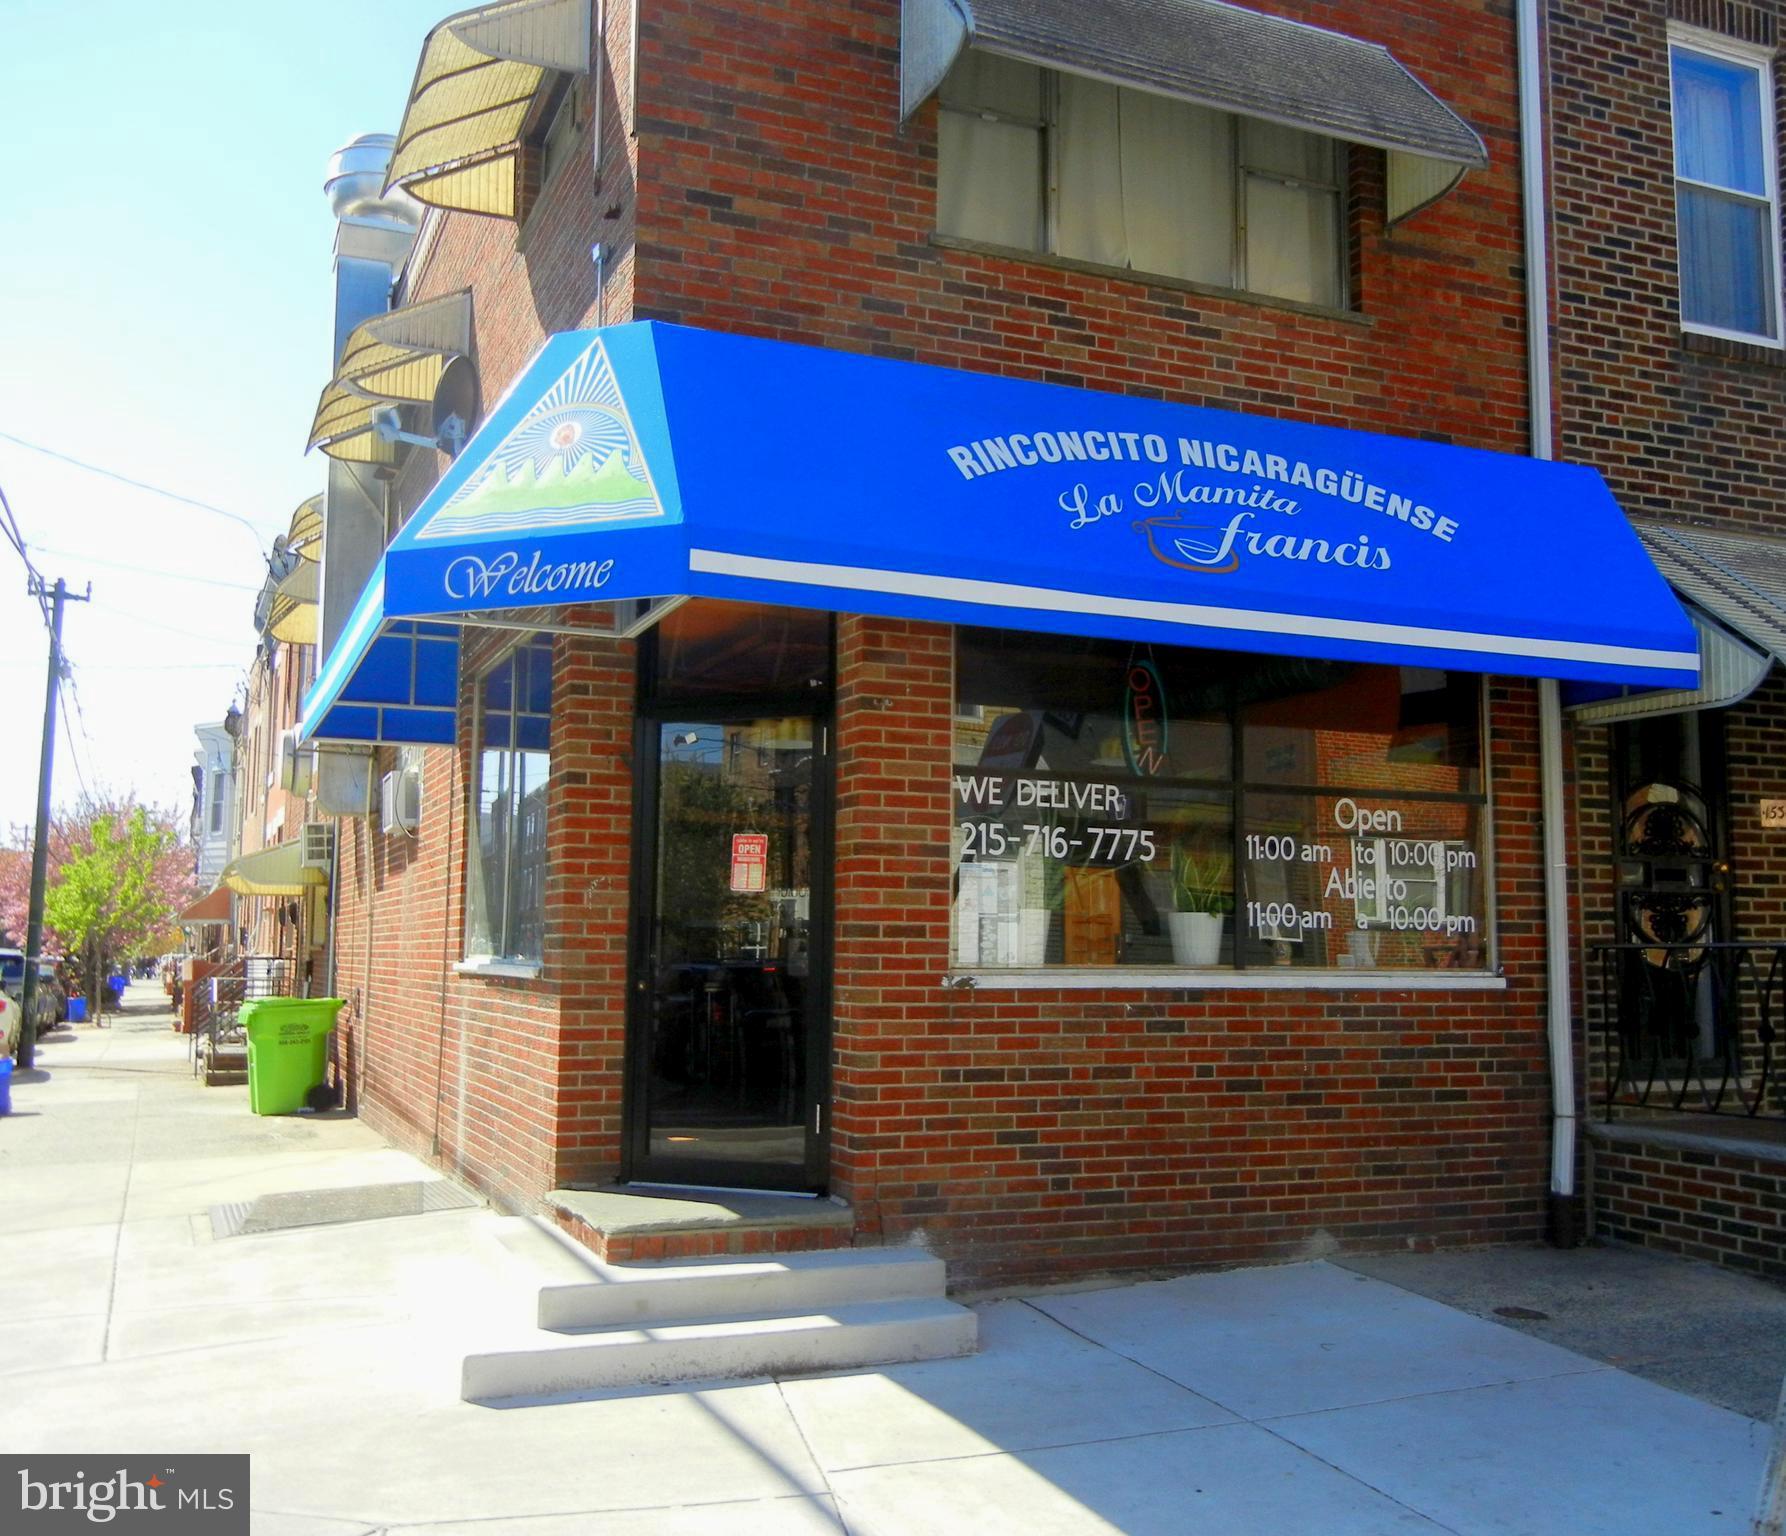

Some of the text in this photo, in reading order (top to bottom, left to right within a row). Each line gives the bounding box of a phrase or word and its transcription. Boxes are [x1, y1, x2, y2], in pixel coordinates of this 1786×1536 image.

[947, 430, 1460, 543] RINCONCITO NICARAGÜENSE
[1058, 469, 1302, 530] La Mamita
[444, 550, 615, 599] Welcome
[1129, 667, 1167, 776] OPEN
[956, 775, 1121, 812] WE DELIVER
[1334, 797, 1402, 837] Open
[738, 844, 761, 854] OPEN
[959, 821, 1156, 862] 215-716-7775
[1246, 834, 1477, 873] 11:00 am to 10:00 pm
[1323, 866, 1407, 901] Abieto
[1247, 901, 1476, 937] 11:00 am a 10:00 pm
